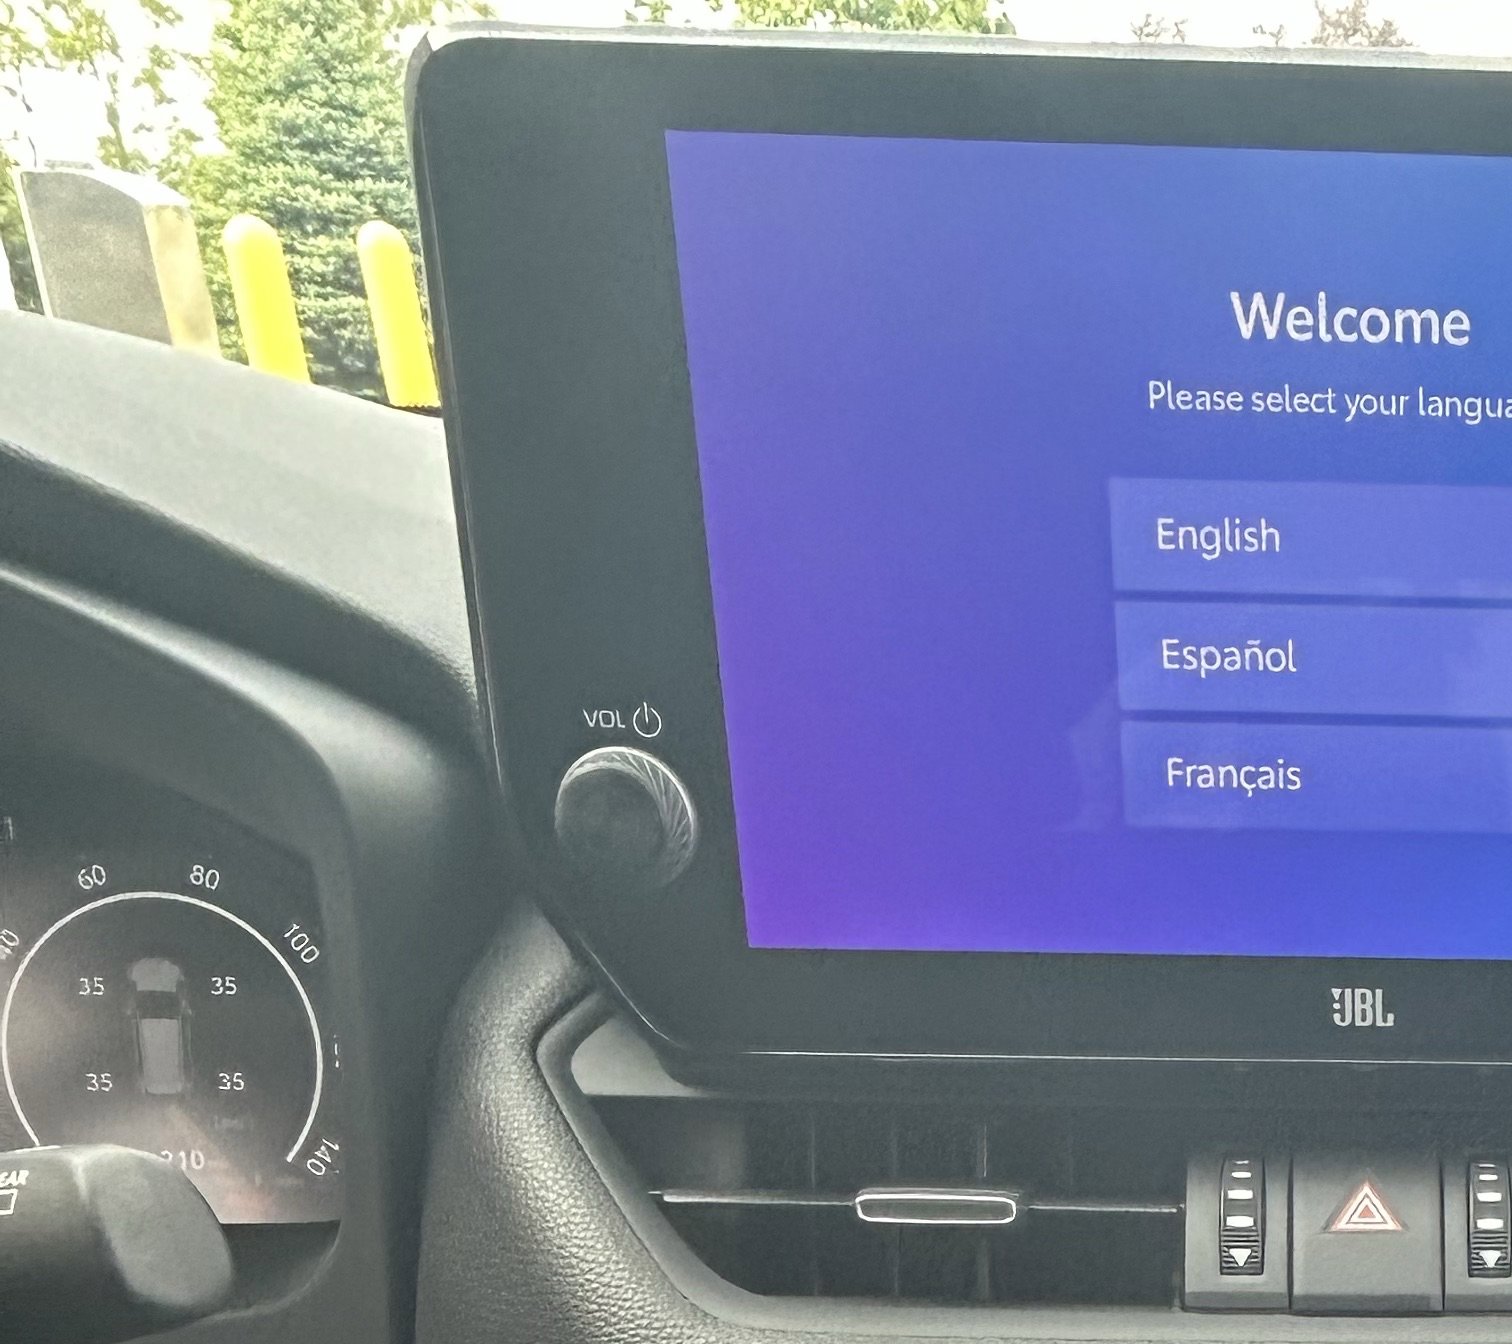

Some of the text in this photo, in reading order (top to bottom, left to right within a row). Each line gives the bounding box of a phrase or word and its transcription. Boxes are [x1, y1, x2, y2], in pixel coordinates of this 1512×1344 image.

[1229, 290, 1471, 347] Welcome
[1147, 379, 1245, 413] Please
[1250, 383, 1338, 416] select
[1343, 391, 1411, 424] your
[1156, 516, 1281, 561] English
[1161, 638, 1298, 678] Español
[582, 708, 626, 729] VOL
[1166, 756, 1302, 797] Français
[77, 864, 107, 890] 60
[188, 863, 221, 892] 80
[282, 922, 321, 966] 100
[78, 976, 105, 997] 35
[210, 975, 238, 996] 35
[1330, 986, 1396, 1028] JBL
[85, 1071, 114, 1092] 35
[218, 1071, 246, 1092] 35
[306, 1138, 340, 1176] 140
